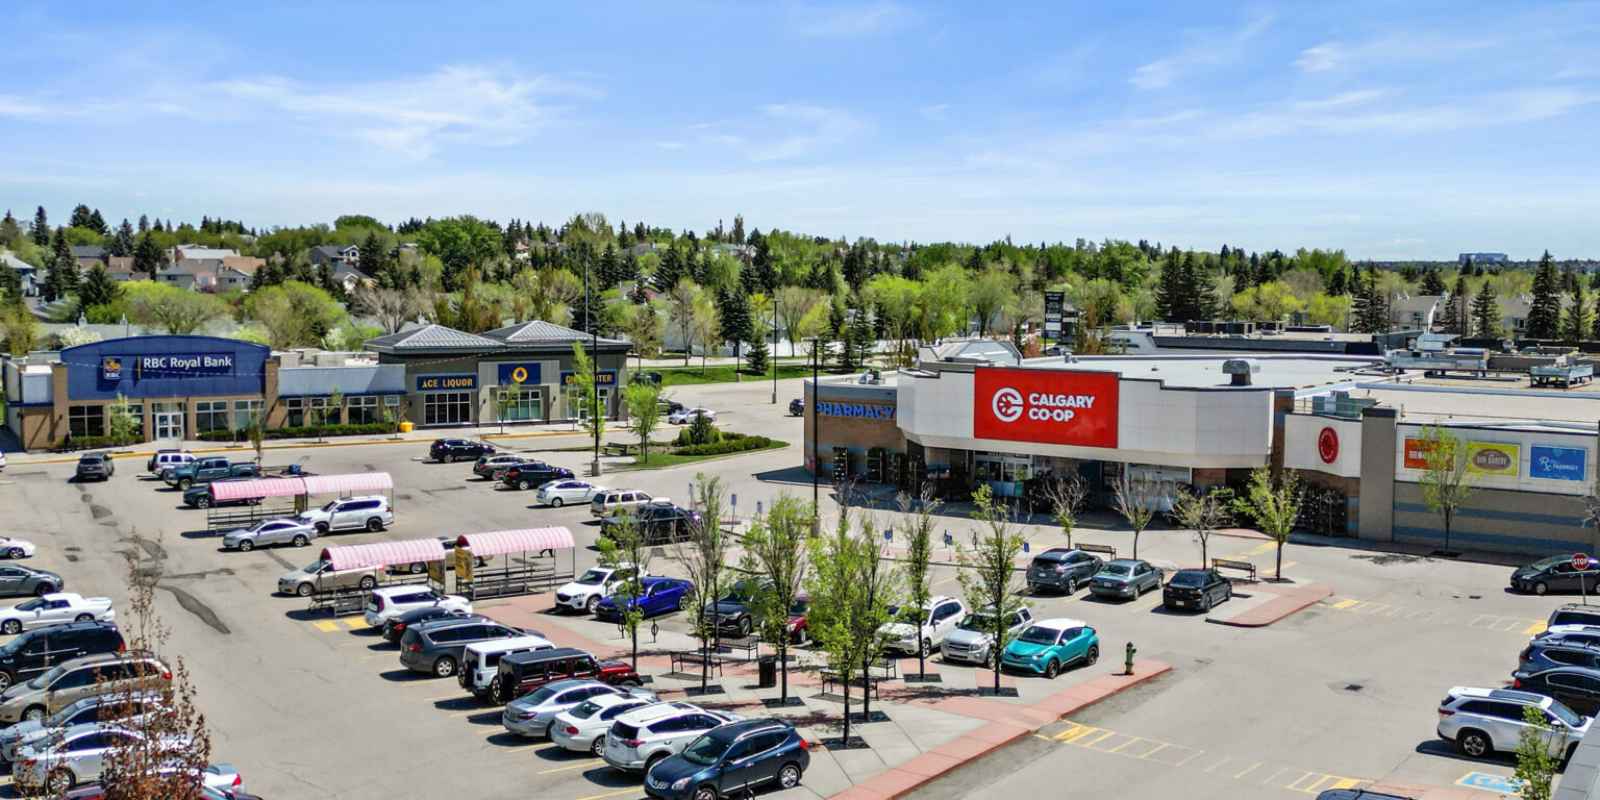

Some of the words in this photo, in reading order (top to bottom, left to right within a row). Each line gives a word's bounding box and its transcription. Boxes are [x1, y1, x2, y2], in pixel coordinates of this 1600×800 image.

[143, 357, 166, 369] RBC
[170, 355, 200, 370] Royal
[204, 355, 232, 368] Bank
[422, 379, 438, 388] ACE
[442, 378, 472, 387] LIQUOR
[1029, 393, 1095, 408] CALGARY
[1028, 408, 1074, 421] CO-OP
[1573, 557, 1588, 566] STOP
